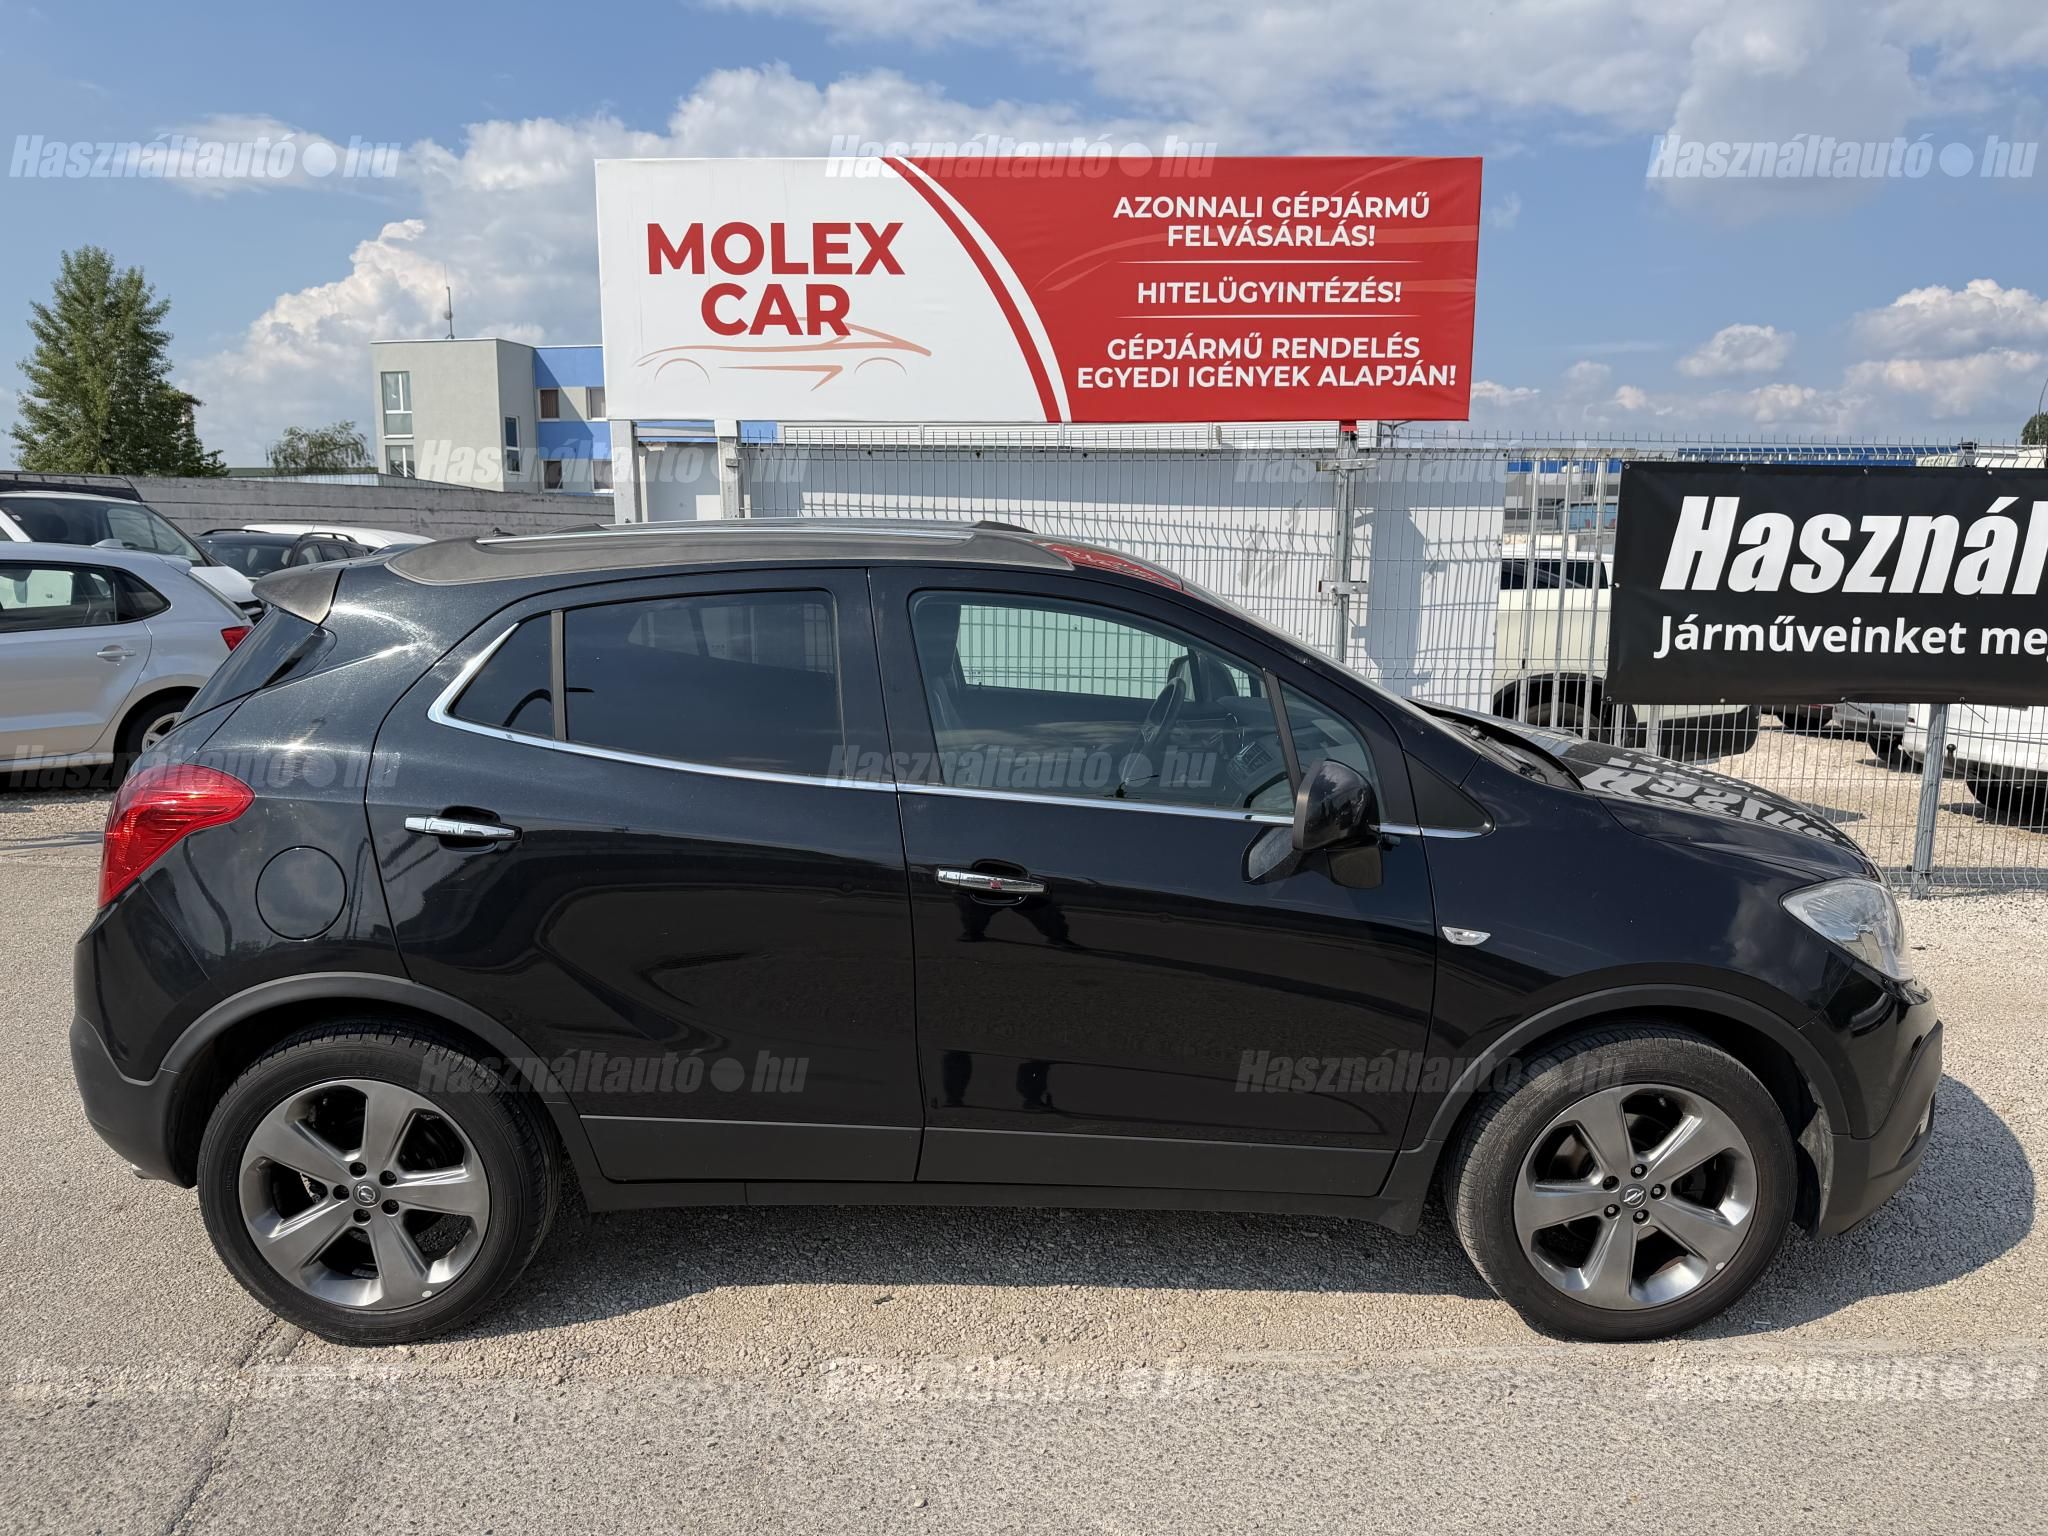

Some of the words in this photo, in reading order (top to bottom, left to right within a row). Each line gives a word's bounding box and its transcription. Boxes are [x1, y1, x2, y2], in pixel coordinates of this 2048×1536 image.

[1112, 195, 1264, 219] AZONNALI
[1271, 191, 1431, 219] GÉPJÁRMŰ
[1167, 220, 1376, 247] FELVÁSÁRLÁS!
[647, 222, 906, 275] MOLEX
[1137, 276, 1402, 304] HITELÜGYINTÉZÉS!
[701, 283, 851, 336] CAR
[1107, 332, 1263, 361] GÉPJÁRMŰ
[1271, 332, 1421, 360] RENDELÉS
[1077, 366, 1179, 389] EGYEDI
[1188, 361, 1311, 388] IGÉNYEK
[1316, 360, 1457, 388] ALAPJÁN!
[1659, 495, 2048, 596] Használ
[1653, 614, 1967, 659] Járműveinket
[1980, 627, 2048, 661] me
